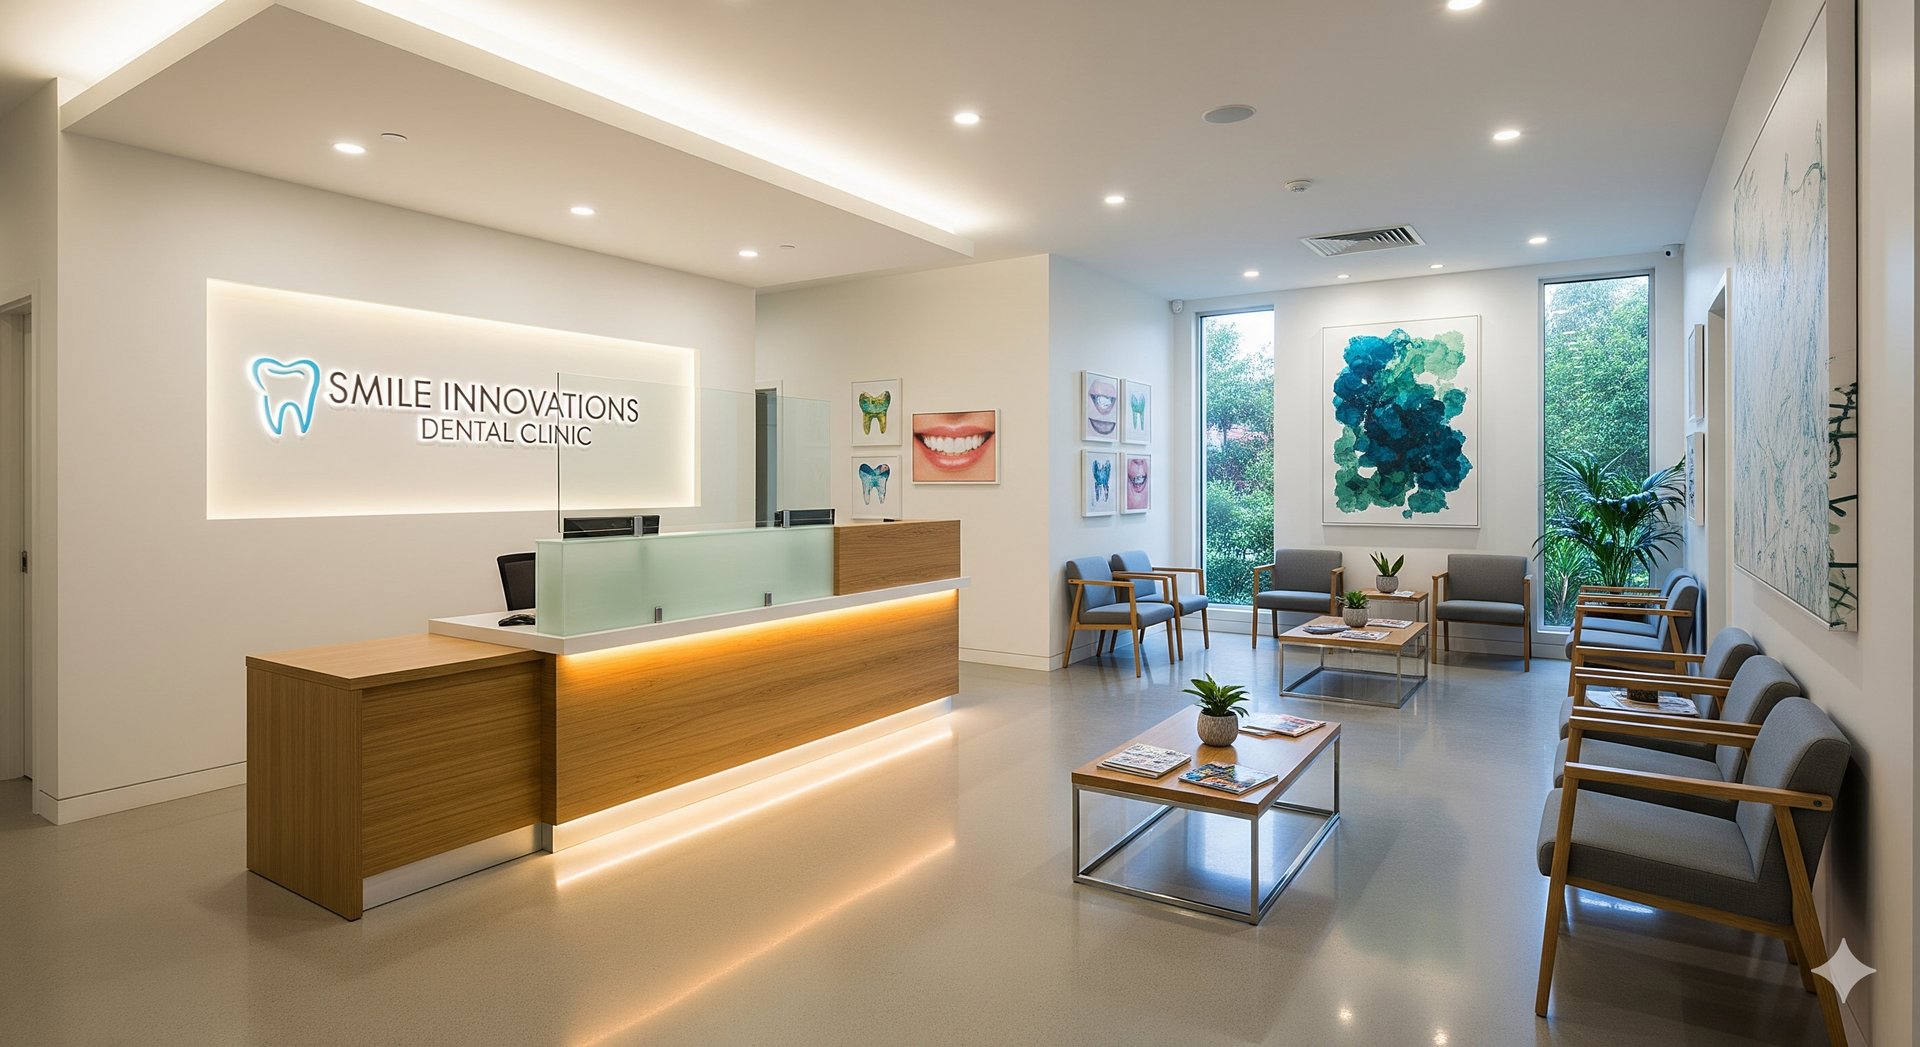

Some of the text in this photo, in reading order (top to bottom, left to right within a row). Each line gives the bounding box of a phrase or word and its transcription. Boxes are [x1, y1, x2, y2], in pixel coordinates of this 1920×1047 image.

[328, 371, 640, 422] SMILE INNOVATIONS
[422, 418, 592, 446] DENTAL CLINIC
